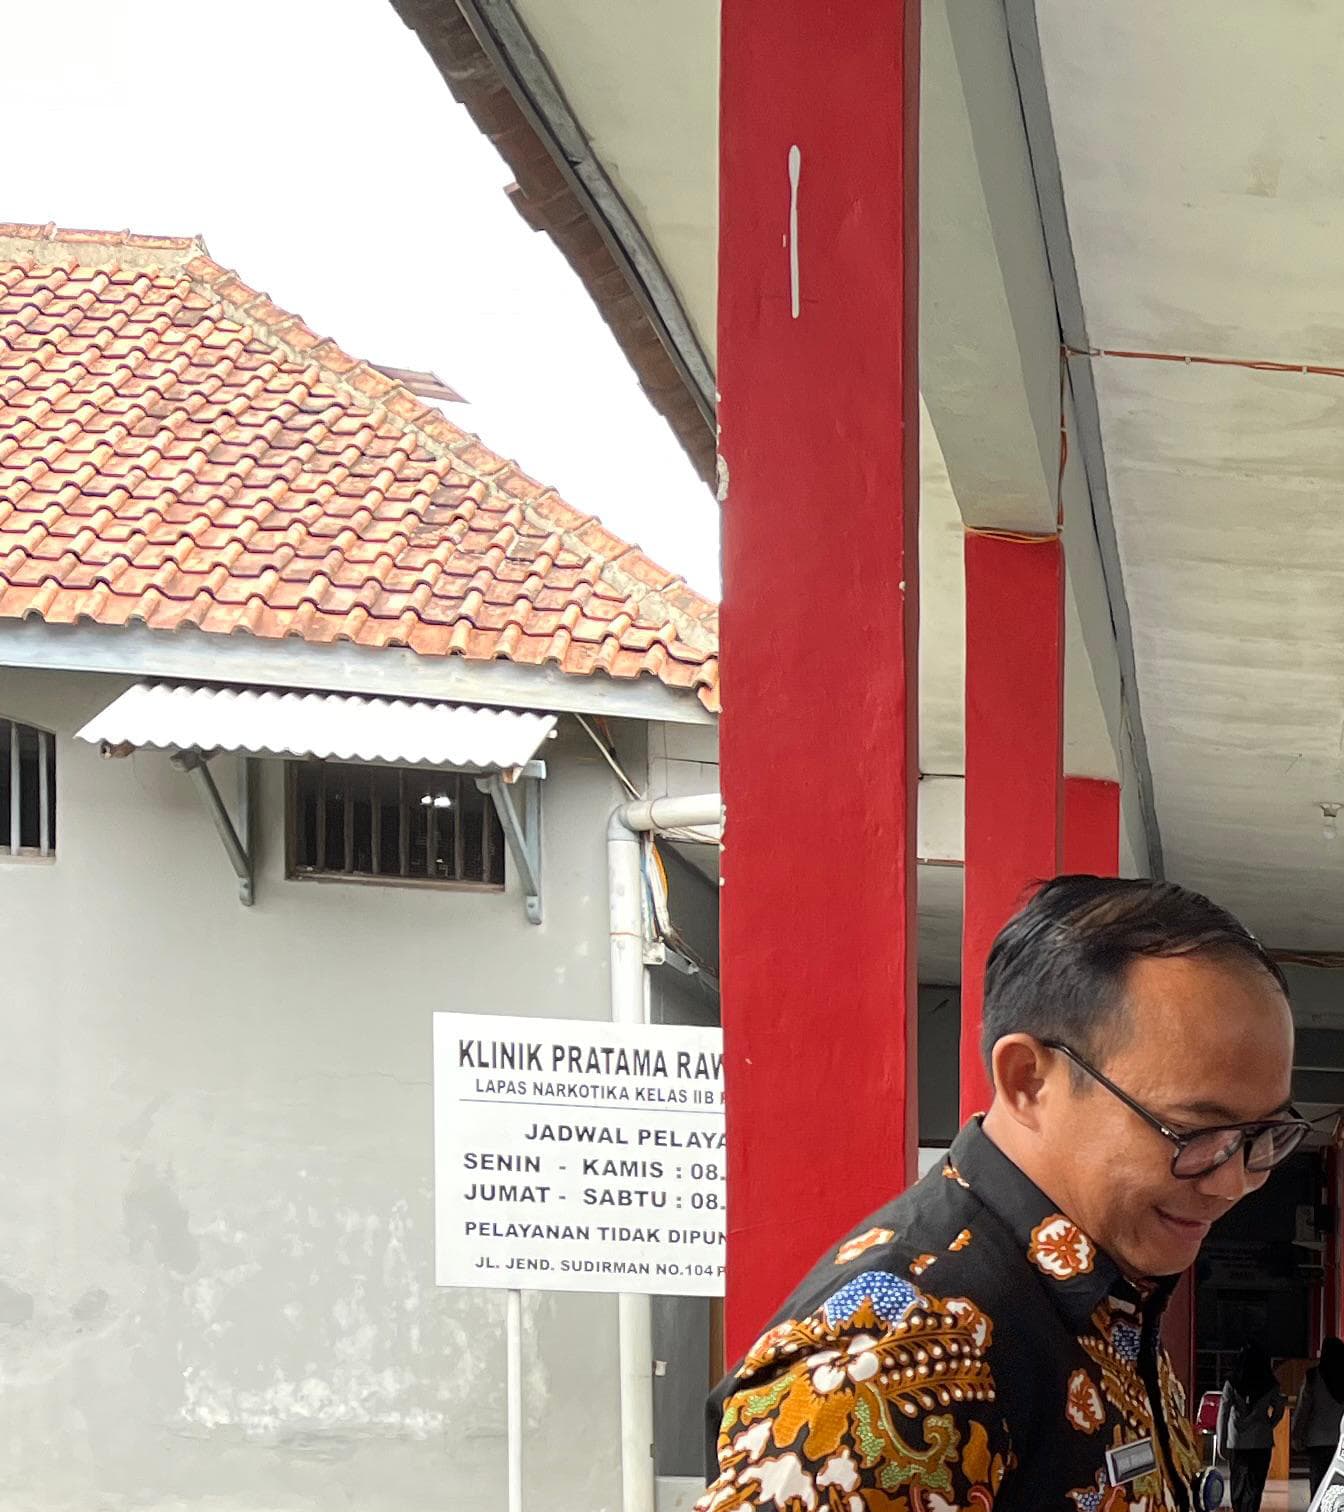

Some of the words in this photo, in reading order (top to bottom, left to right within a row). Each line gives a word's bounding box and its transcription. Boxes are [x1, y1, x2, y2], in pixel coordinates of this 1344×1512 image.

[458, 1038, 543, 1072] KLINIK
[552, 1044, 668, 1078] PRATAMA
[476, 1078, 527, 1095] LAPAS
[533, 1082, 629, 1100] NARKOTIKA
[635, 1087, 687, 1103] KELAS
[525, 1124, 628, 1145] JADWAL
[464, 1152, 541, 1172] SENIN
[583, 1158, 664, 1179] KAMIS
[464, 1184, 550, 1203] JUMAT
[583, 1188, 667, 1207] SABTU
[465, 1221, 590, 1240] PELAYANAN
[597, 1226, 660, 1243] TIDAK
[475, 1257, 500, 1269] JL.
[505, 1257, 555, 1271] JEND.
[560, 1260, 650, 1275] SUDIRMAN
